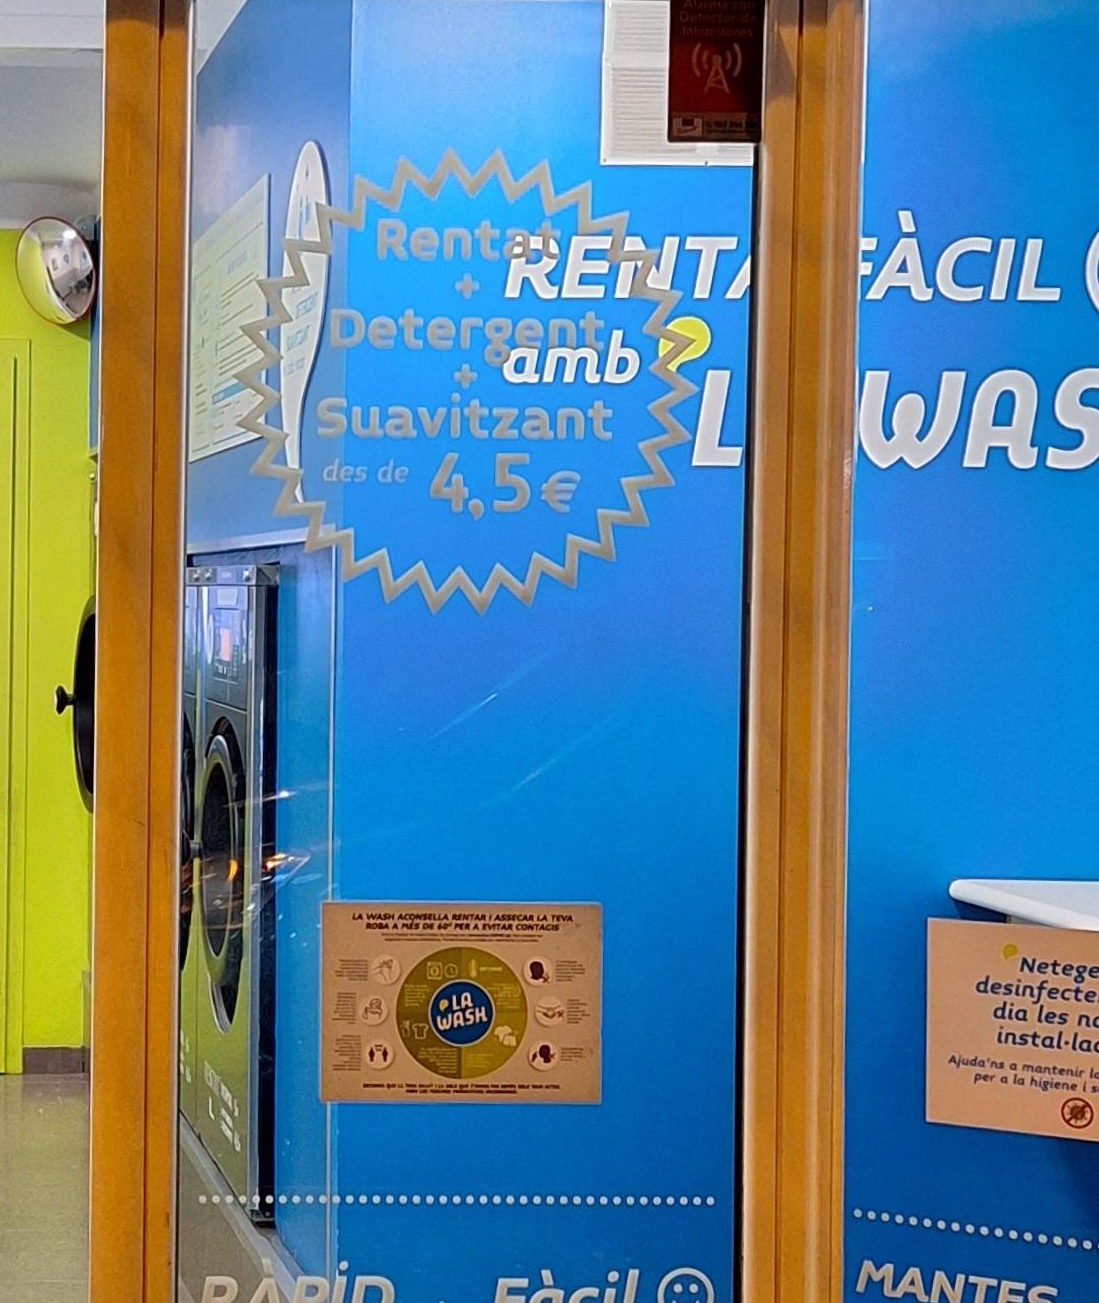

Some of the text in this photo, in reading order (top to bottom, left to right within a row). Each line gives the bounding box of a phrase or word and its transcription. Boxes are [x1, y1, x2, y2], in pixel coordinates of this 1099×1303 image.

[375, 218, 562, 260] Rentat
[329, 308, 606, 364] Detergent
[503, 329, 640, 385] amb
[316, 392, 614, 441] Suavitzant
[322, 457, 369, 485] des
[376, 457, 409, 485] de
[352, 912, 363, 921] LA
[366, 912, 395, 921] WASH
[397, 912, 449, 922] ACONSELLA
[451, 913, 487, 922] RENTAR
[494, 914, 534, 923] ASSECAR
[536, 914, 548, 922] LA
[551, 914, 574, 923] TEVA
[365, 922, 390, 930] ROBA
[481, 923, 514, 931] EVITAR
[451, 992, 474, 1011] LA
[993, 1001, 1029, 1022] dia
[1037, 1004, 1070, 1026] les
[436, 1006, 488, 1031] WASH
[948, 1054, 1005, 1071] Ajuda'ns
[1009, 1061, 1018, 1071] a
[1022, 1061, 1085, 1079] mantenir
[973, 1071, 996, 1085] per
[1000, 1076, 1009, 1085] a
[1012, 1073, 1026, 1086] la
[1029, 1077, 1078, 1092] higiene
